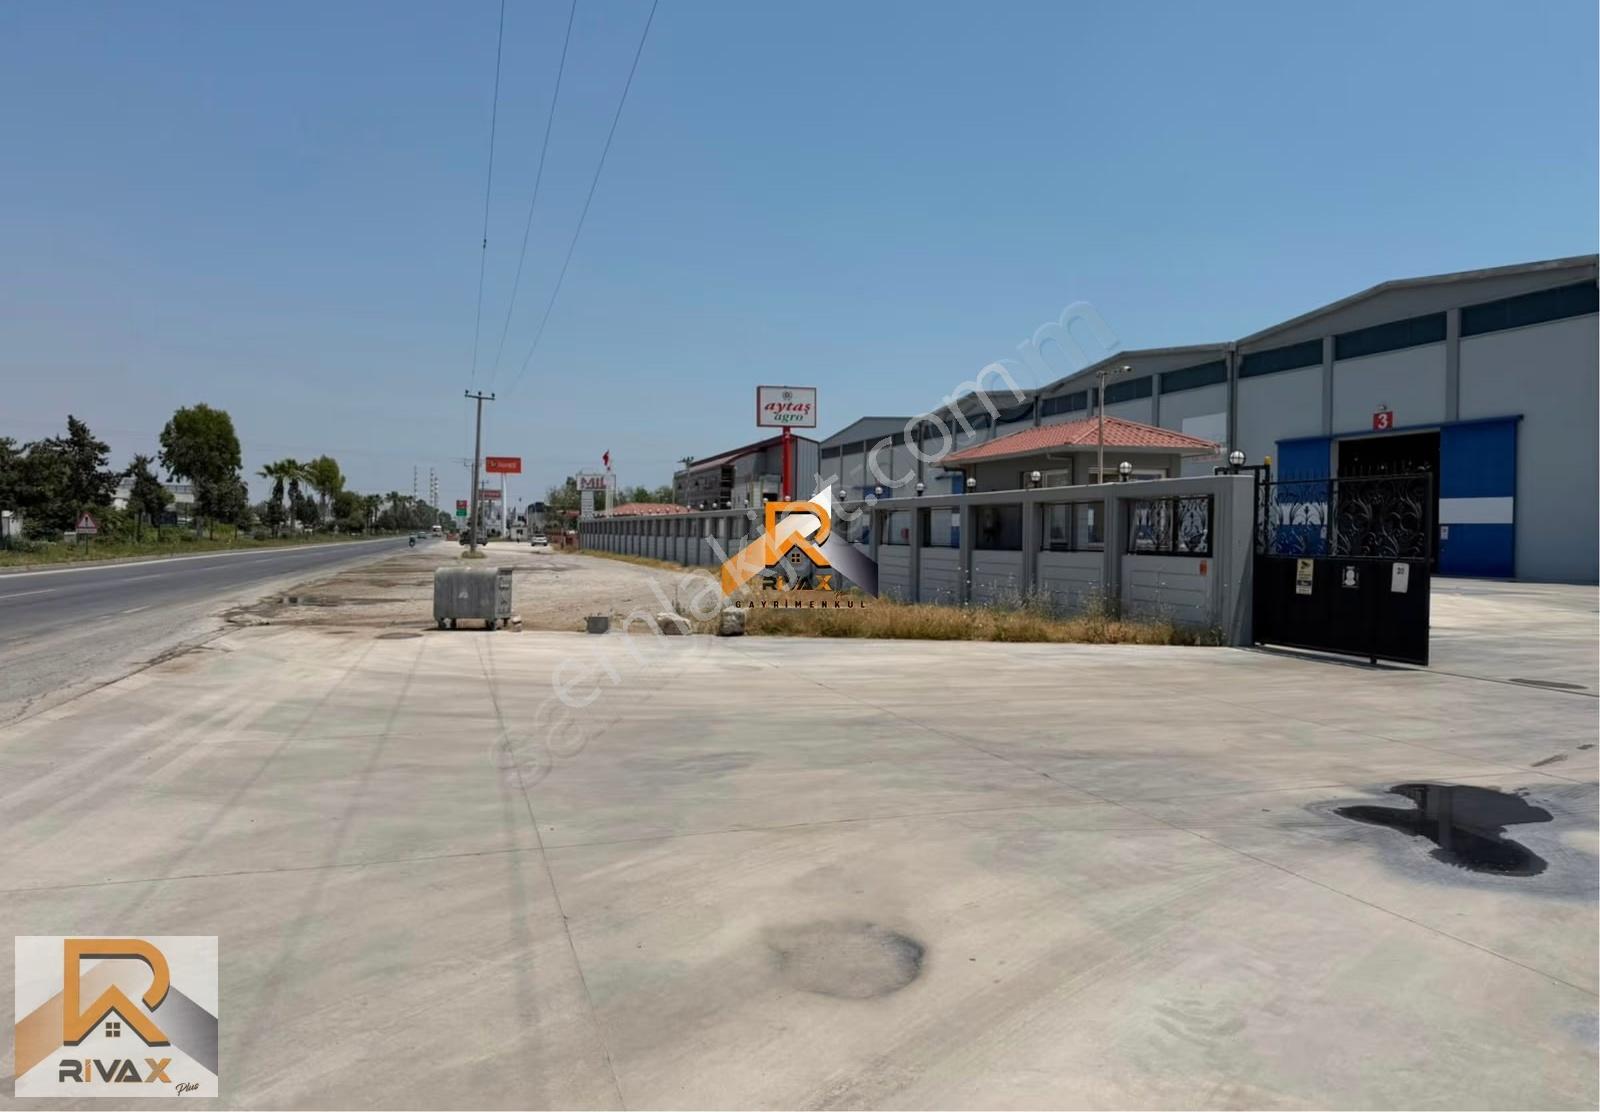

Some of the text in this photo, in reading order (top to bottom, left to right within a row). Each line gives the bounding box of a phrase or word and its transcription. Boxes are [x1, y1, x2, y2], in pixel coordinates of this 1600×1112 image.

[764, 402, 811, 415] aytaş
[774, 413, 804, 423] agro
[1378, 413, 1389, 429] 3
